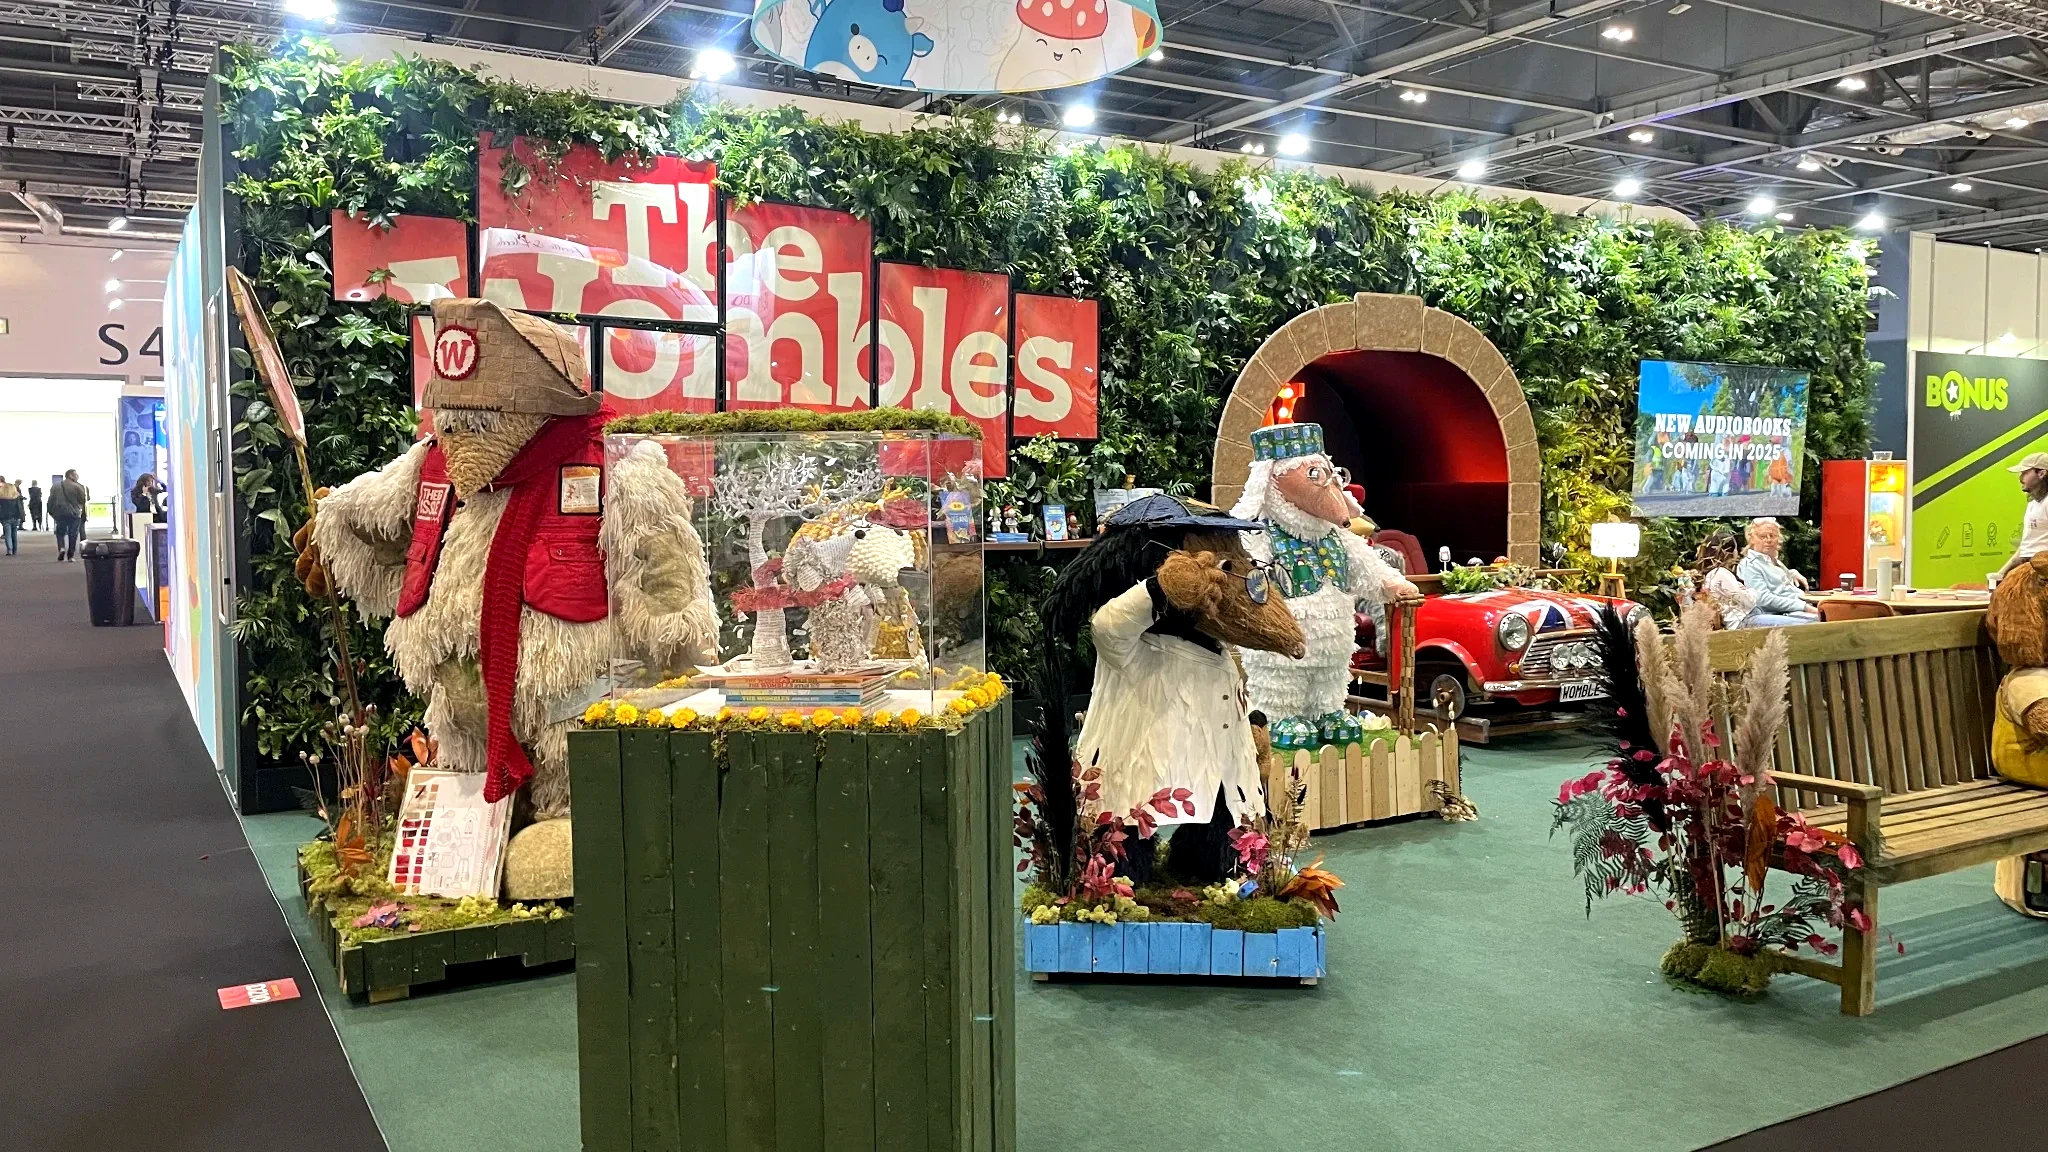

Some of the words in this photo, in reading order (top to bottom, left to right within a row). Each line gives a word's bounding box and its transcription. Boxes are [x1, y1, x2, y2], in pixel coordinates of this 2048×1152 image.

[591, 180, 823, 301] The
[439, 339, 473, 371] W
[1926, 370, 2009, 413] BONUS
[1655, 413, 1692, 433] NEW
[1694, 415, 1792, 437] AUDIOBOOKS
[1662, 442, 1725, 460] COMING
[1729, 444, 1744, 461] IN
[1746, 445, 1781, 461] 2025
[1562, 684, 1601, 700] WOMBLE
